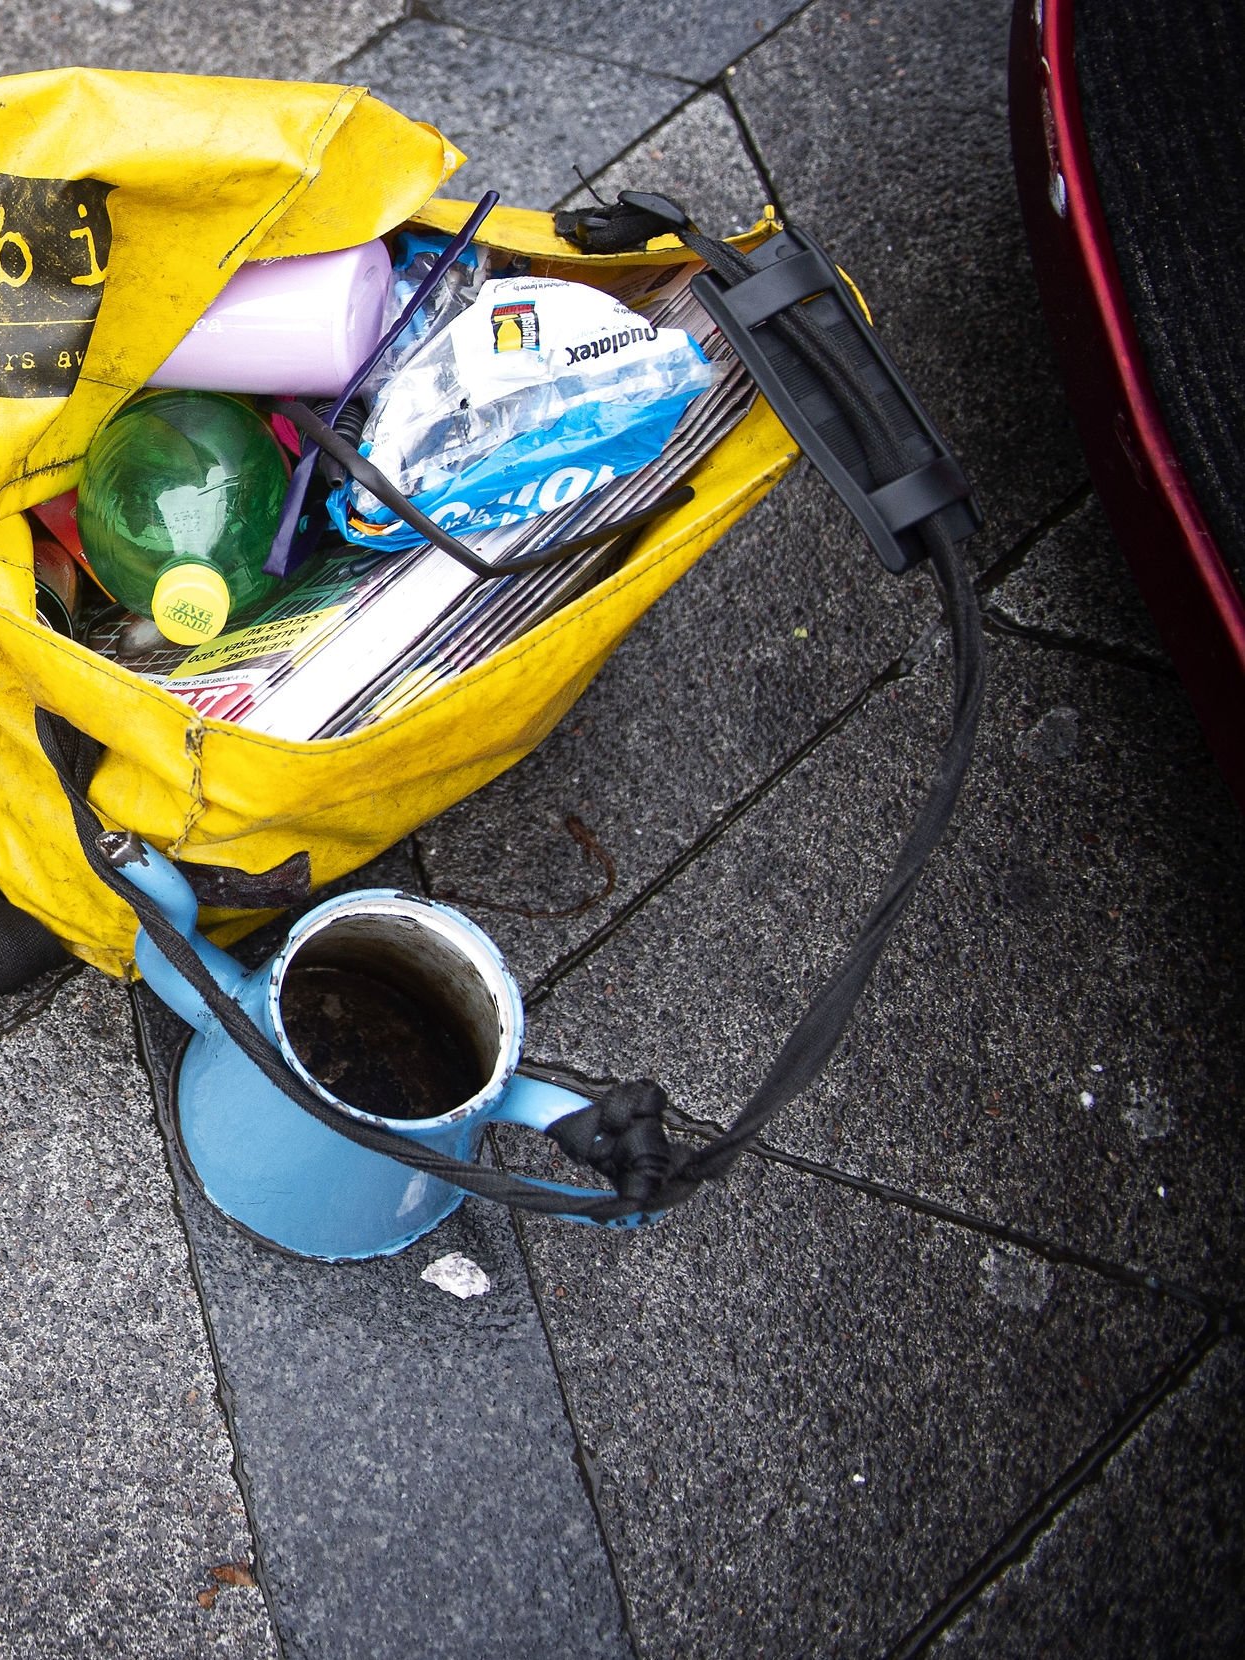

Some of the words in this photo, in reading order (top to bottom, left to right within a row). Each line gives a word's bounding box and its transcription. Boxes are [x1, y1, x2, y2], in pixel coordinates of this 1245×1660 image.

[564, 327, 659, 366] Qualatex
[163, 606, 213, 635] KONDI
[176, 599, 213, 623] FAXE
[243, 626, 266, 638] NU
[188, 650, 220, 664] 2020
